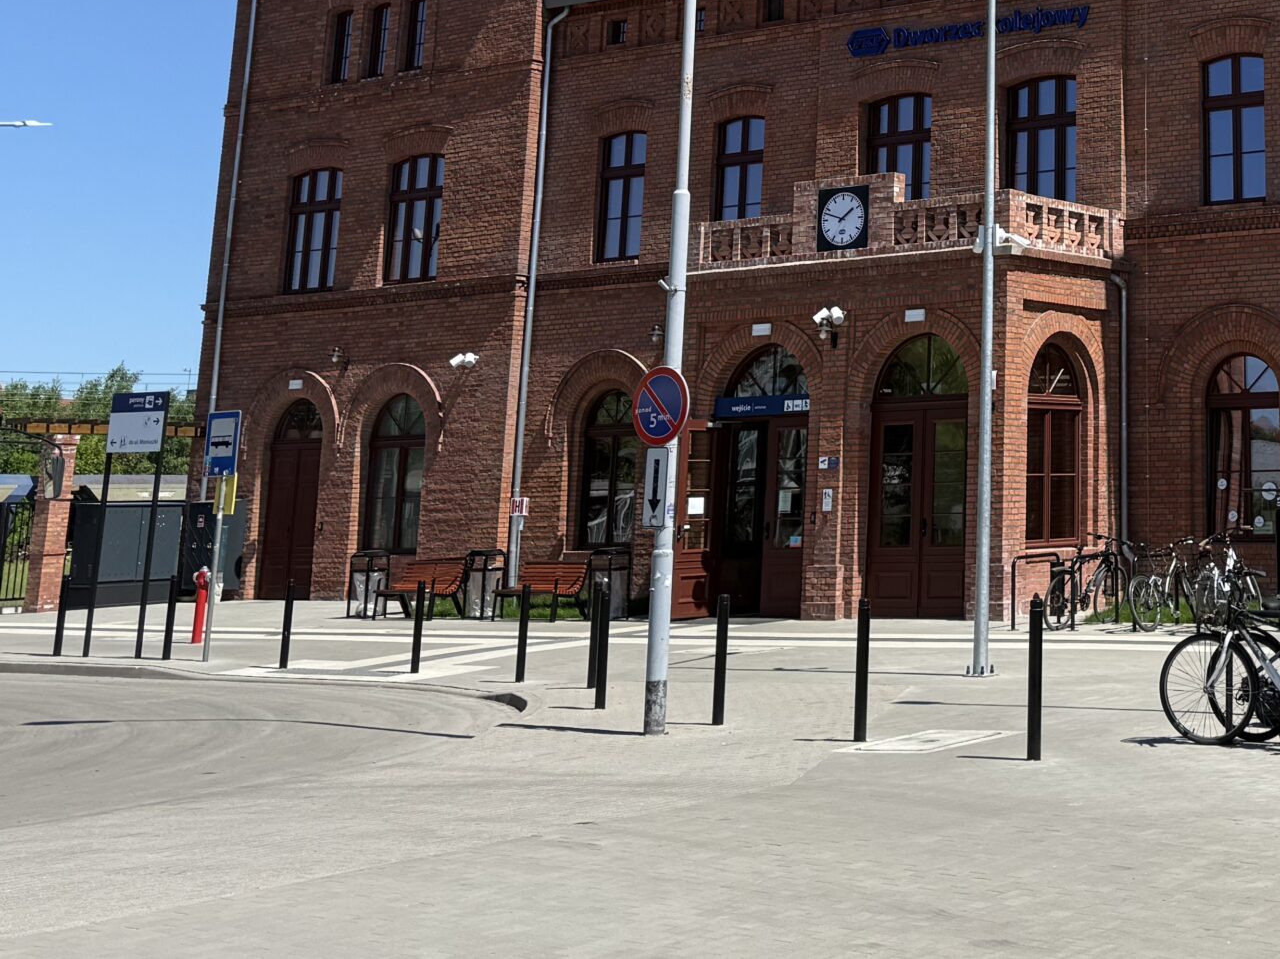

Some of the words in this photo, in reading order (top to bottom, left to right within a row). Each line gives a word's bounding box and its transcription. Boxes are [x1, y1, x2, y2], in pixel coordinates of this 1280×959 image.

[893, 19, 985, 49] Dworzec
[993, 5, 1090, 34] olejowy
[649, 413, 657, 428] 5
